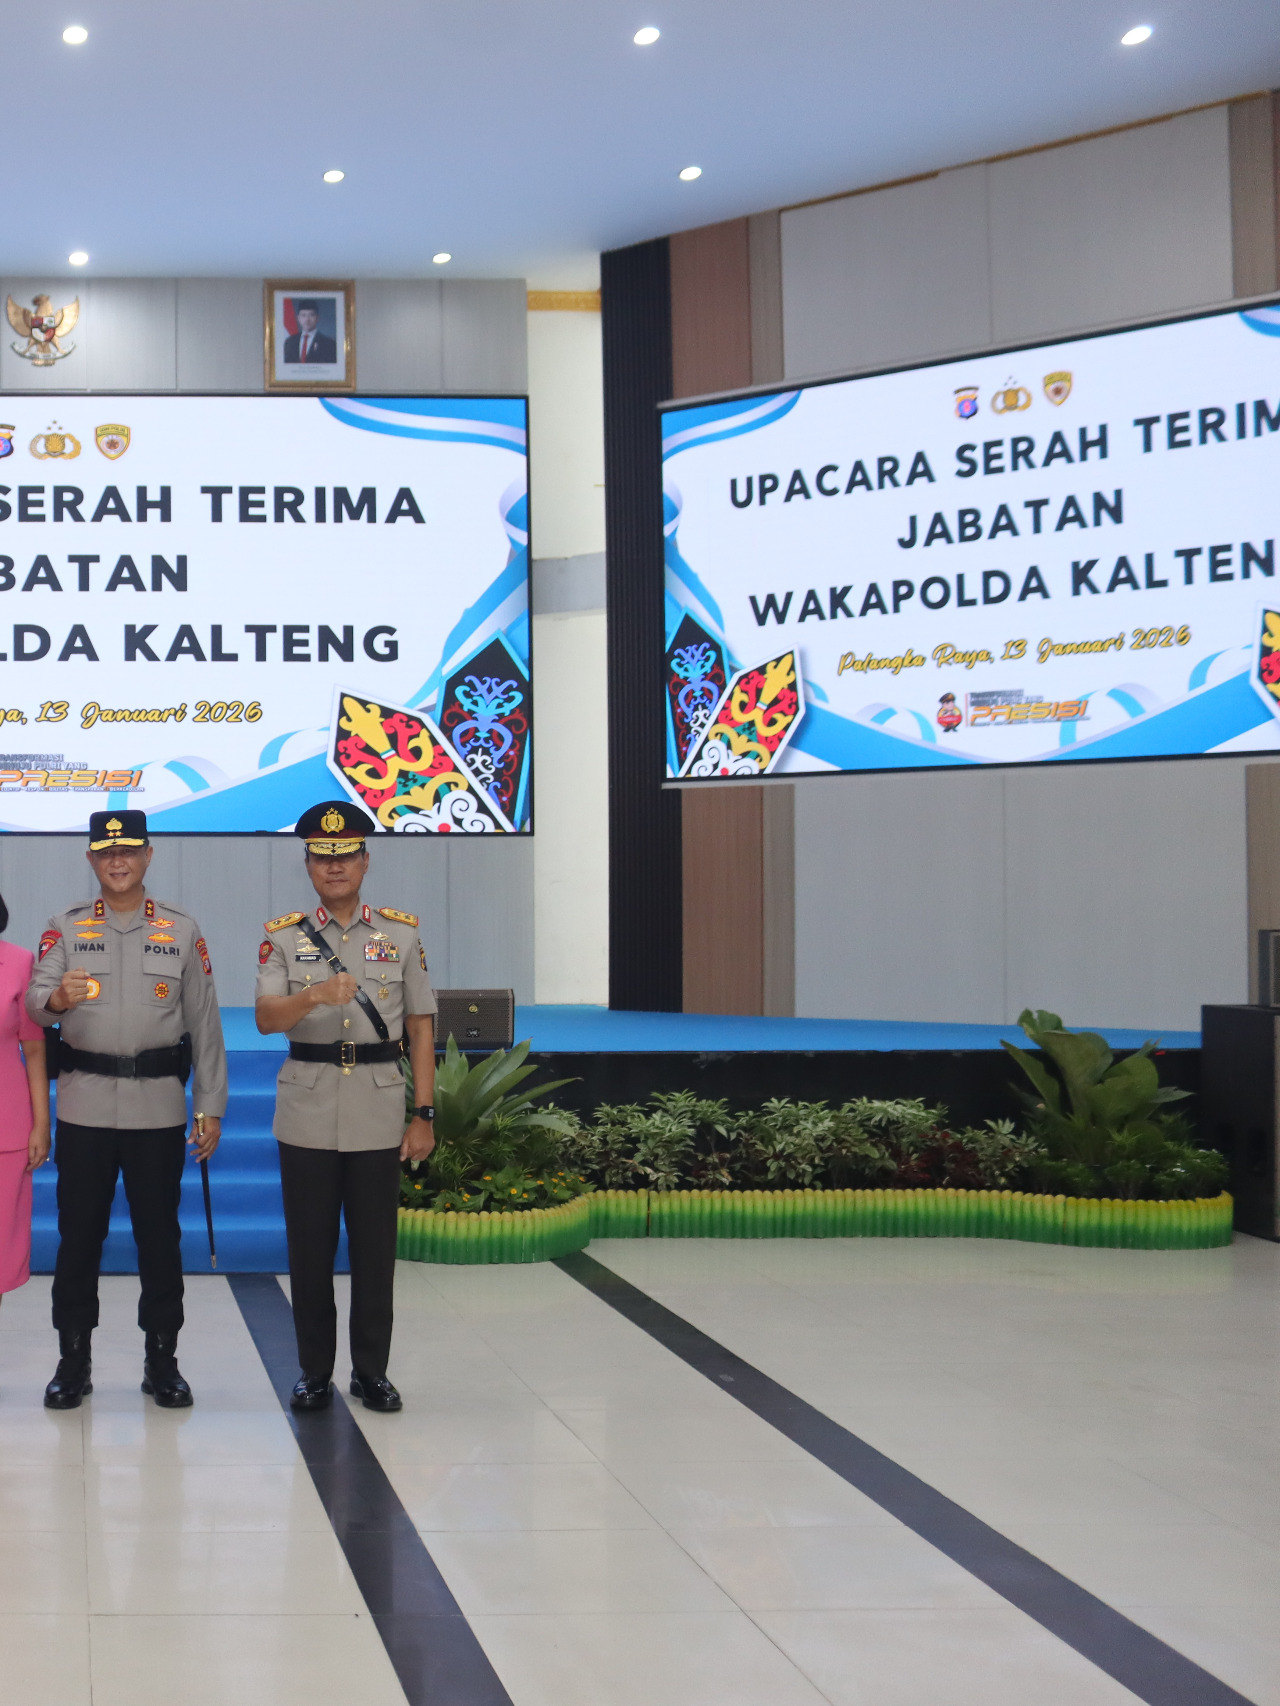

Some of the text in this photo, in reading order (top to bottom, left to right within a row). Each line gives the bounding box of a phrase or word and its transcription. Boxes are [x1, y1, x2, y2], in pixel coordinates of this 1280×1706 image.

[730, 451, 936, 509] UPACARA
[955, 423, 1108, 478] SERAH
[200, 485, 426, 524] TERIMA
[897, 488, 1123, 549] JABATAN
[748, 539, 1275, 627] WAKAPOLDA KALTEN
[124, 624, 399, 663] KALTENG
[837, 624, 1191, 676] Palangka Raya, 13 Januari 2026
[34, 700, 70, 723] 13
[80, 701, 188, 730] Januari
[192, 700, 263, 723] 2026
[970, 700, 1088, 722] PRESISI
[74, 943, 105, 952] IWAN
[144, 945, 180, 956] POLRI
